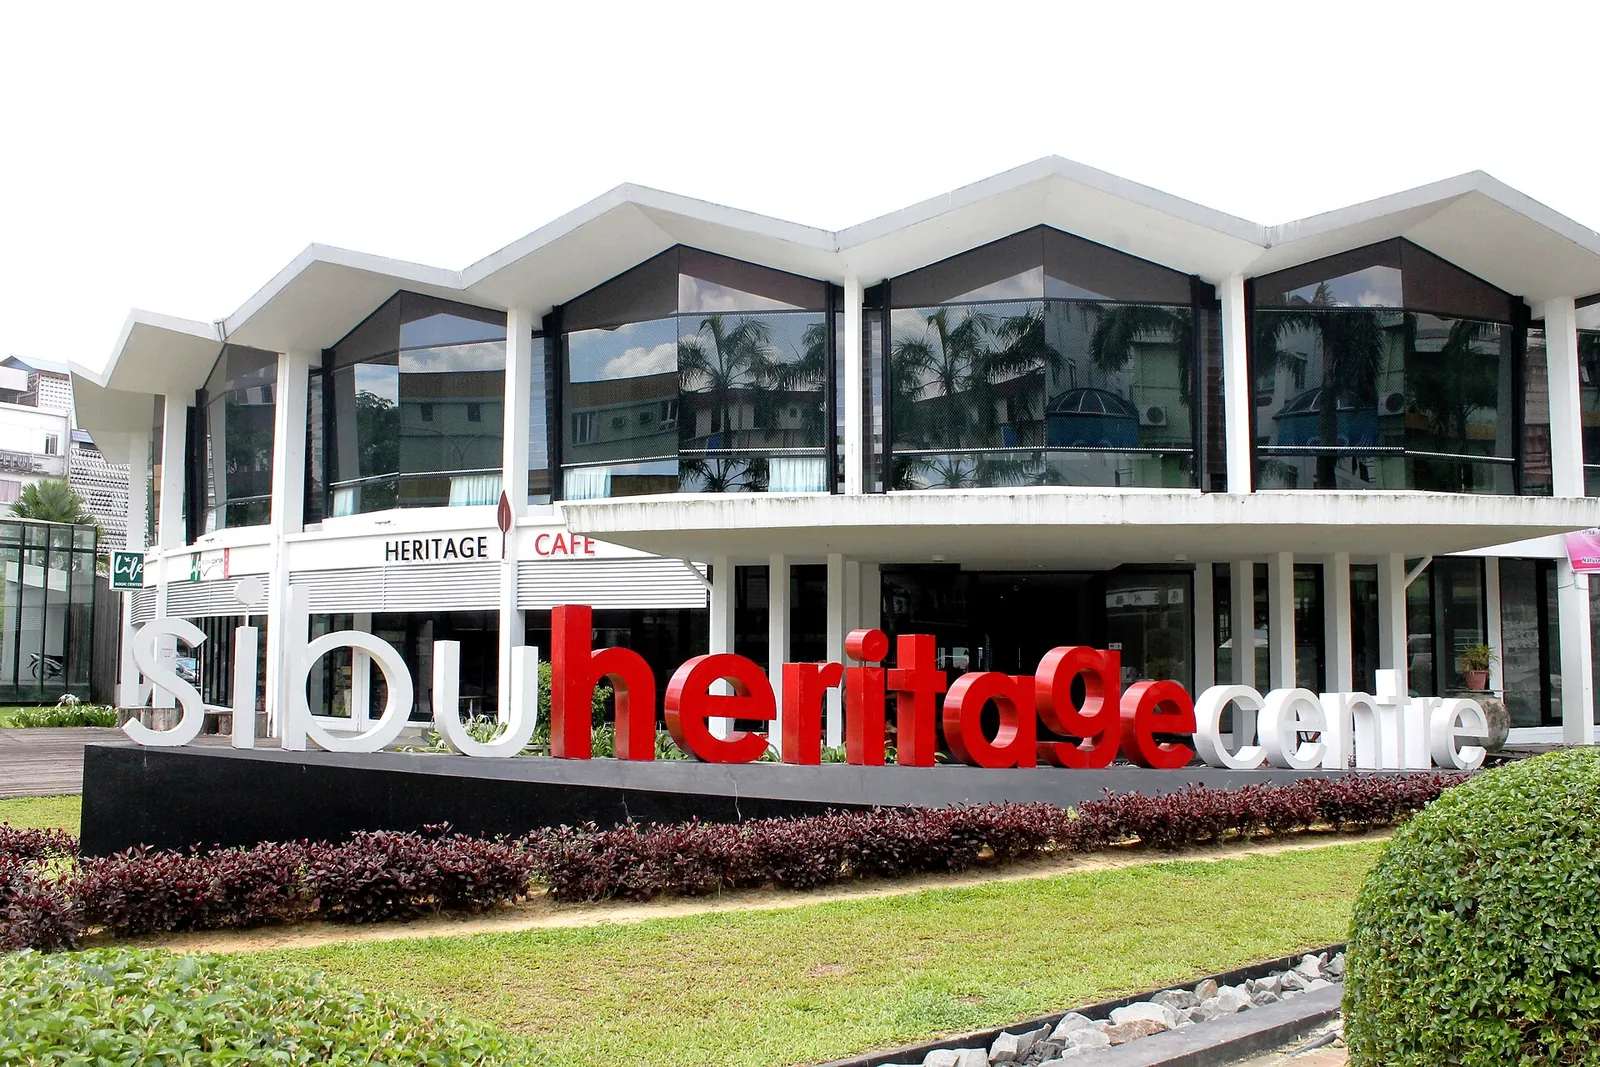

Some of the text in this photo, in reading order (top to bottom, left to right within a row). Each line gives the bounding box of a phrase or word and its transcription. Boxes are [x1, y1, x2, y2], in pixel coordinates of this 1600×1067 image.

[385, 533, 596, 561] HERITAGE CAFE
[115, 554, 144, 581] Life
[123, 577, 1490, 770] sibu heritage centre
